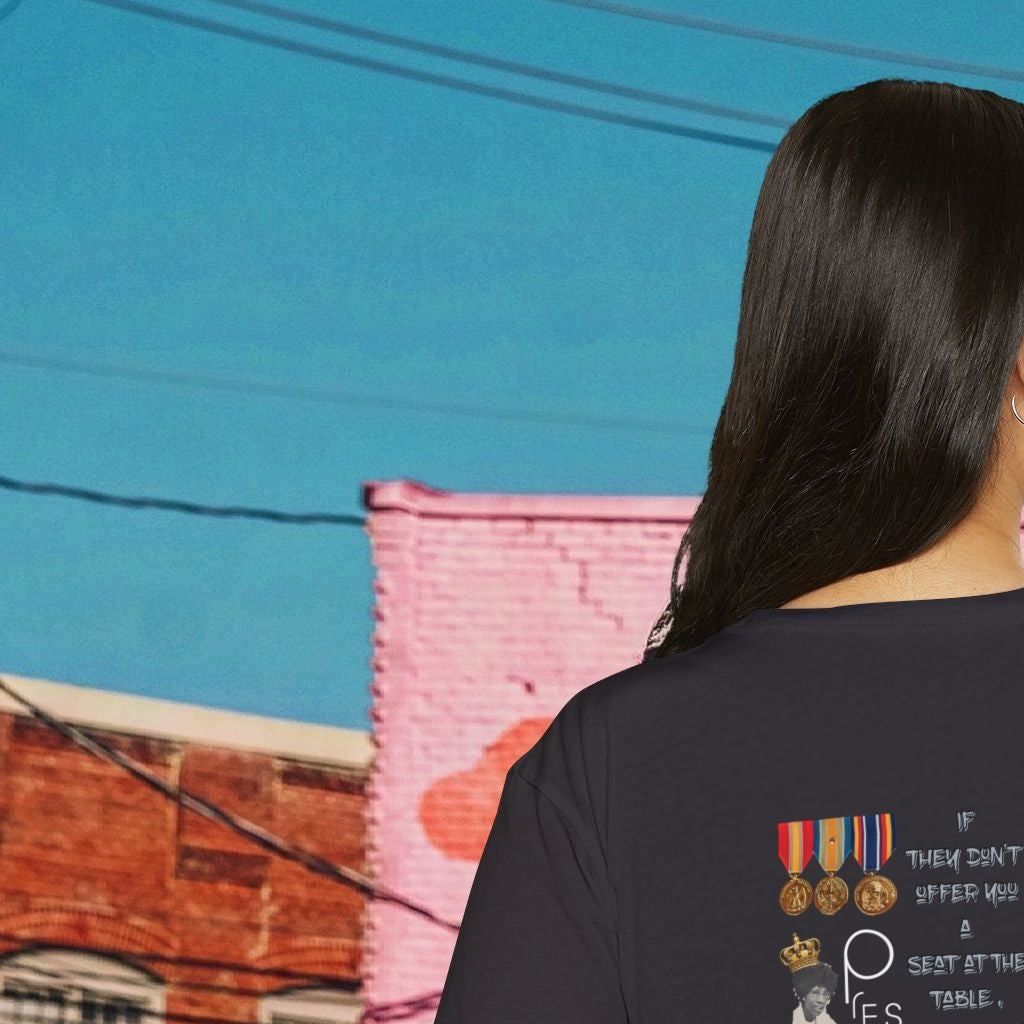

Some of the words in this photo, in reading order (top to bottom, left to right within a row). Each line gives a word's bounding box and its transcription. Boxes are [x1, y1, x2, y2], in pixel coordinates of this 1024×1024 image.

[957, 811, 976, 833] IF
[905, 848, 961, 874] THEY
[966, 843, 1024, 867] DON'T
[915, 883, 979, 905] OFFER
[984, 882, 1019, 909] YOU
[959, 919, 974, 940] A
[907, 954, 961, 976] SEAT
[963, 953, 988, 975] AT
